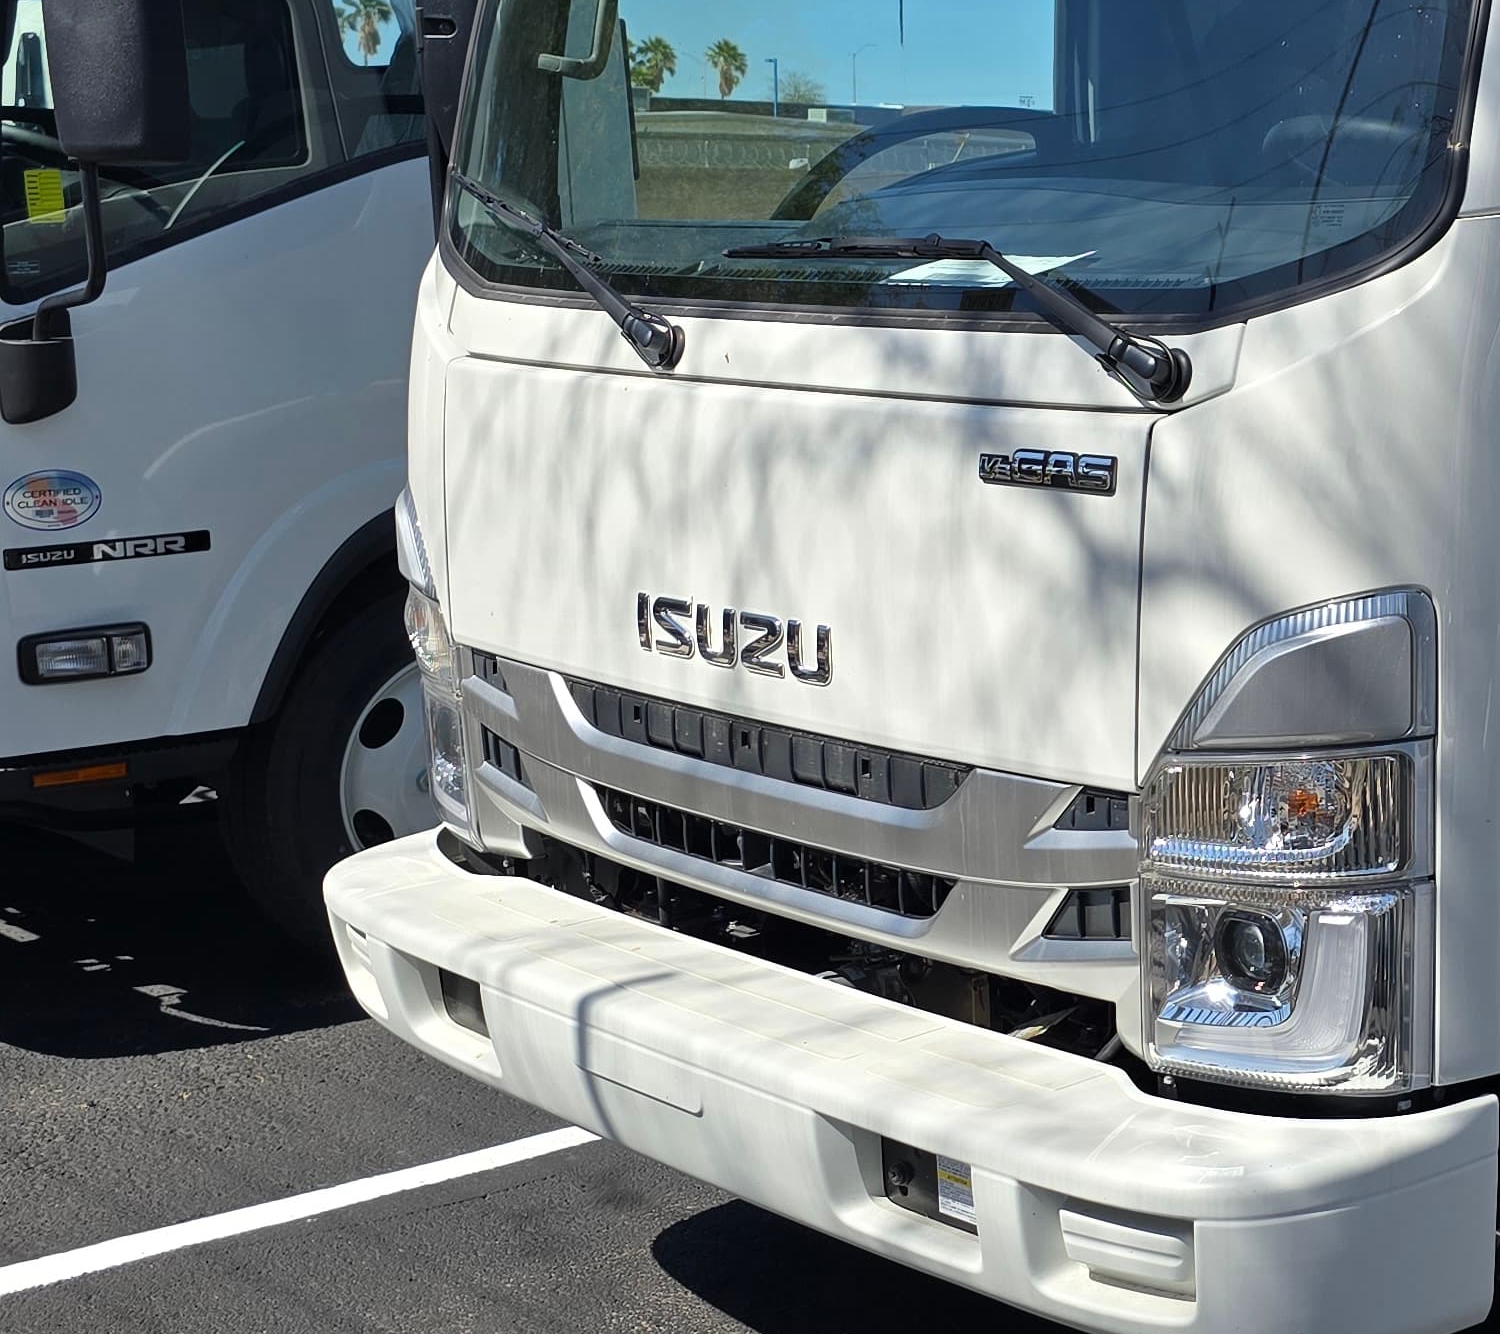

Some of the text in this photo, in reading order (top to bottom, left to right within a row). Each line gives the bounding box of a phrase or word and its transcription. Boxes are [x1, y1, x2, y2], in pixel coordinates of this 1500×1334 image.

[17, 496, 89, 509] CLEAN IDLE
[22, 487, 81, 499] CERTIFIED
[22, 536, 186, 564] ISUZU NRR
[637, 592, 833, 687] ISUZU
